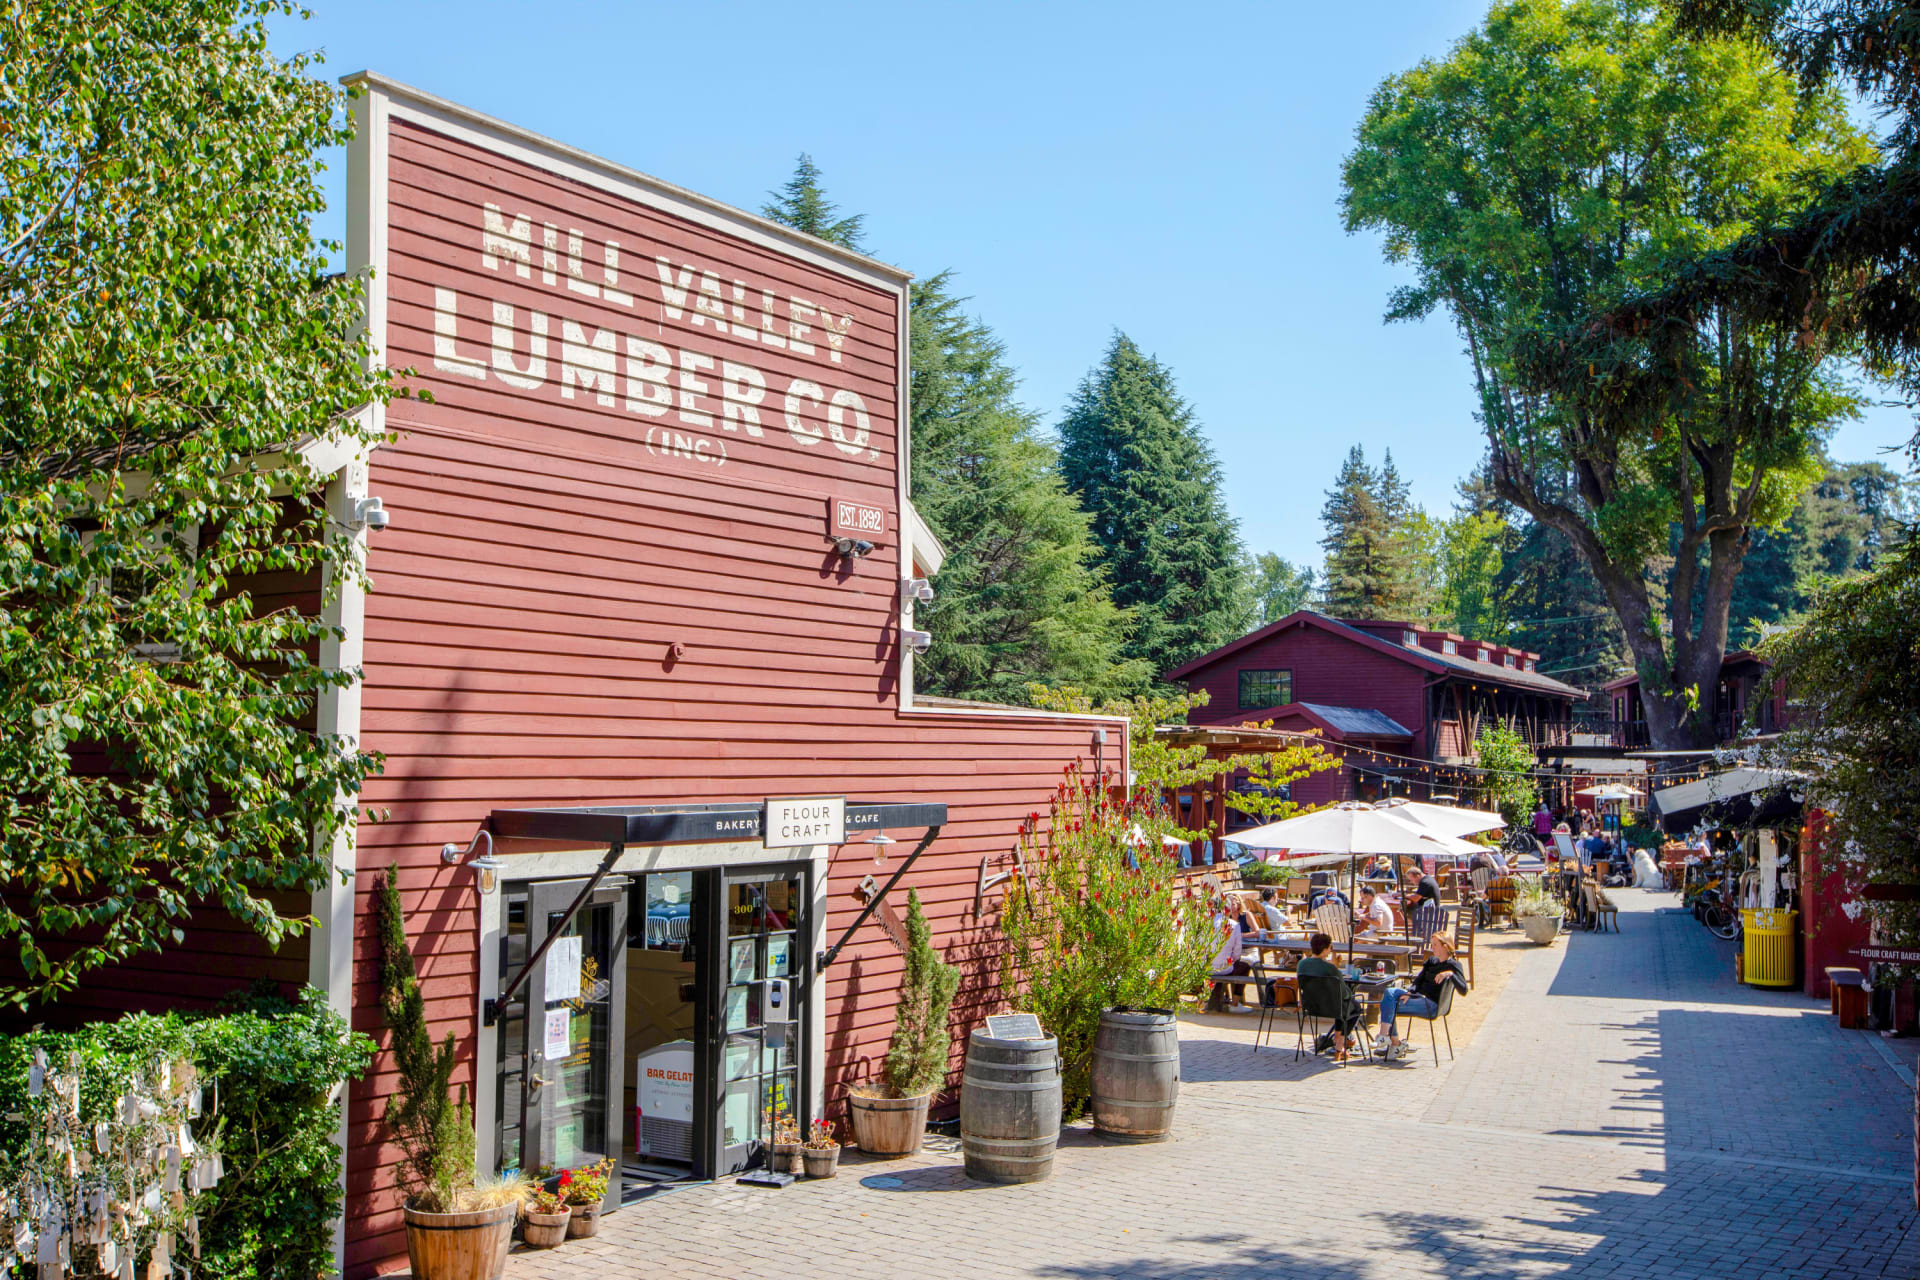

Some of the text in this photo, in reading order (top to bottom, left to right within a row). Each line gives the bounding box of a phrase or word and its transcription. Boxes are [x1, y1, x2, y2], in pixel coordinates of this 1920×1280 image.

[482, 202, 855, 364] MILL VALLEY
[433, 286, 766, 439] LUMBER
[645, 427, 727, 467] (INC.)
[858, 508, 881, 531] 1892
[783, 806, 830, 820] FLOUR
[716, 814, 879, 831] BAKERY & CAFE
[781, 824, 831, 838] CRAFT
[734, 904, 753, 914] 300
[1860, 948, 1880, 958] FLOUR
[1881, 949, 1899, 960] CRAFT
[647, 1068, 665, 1079] BAR
